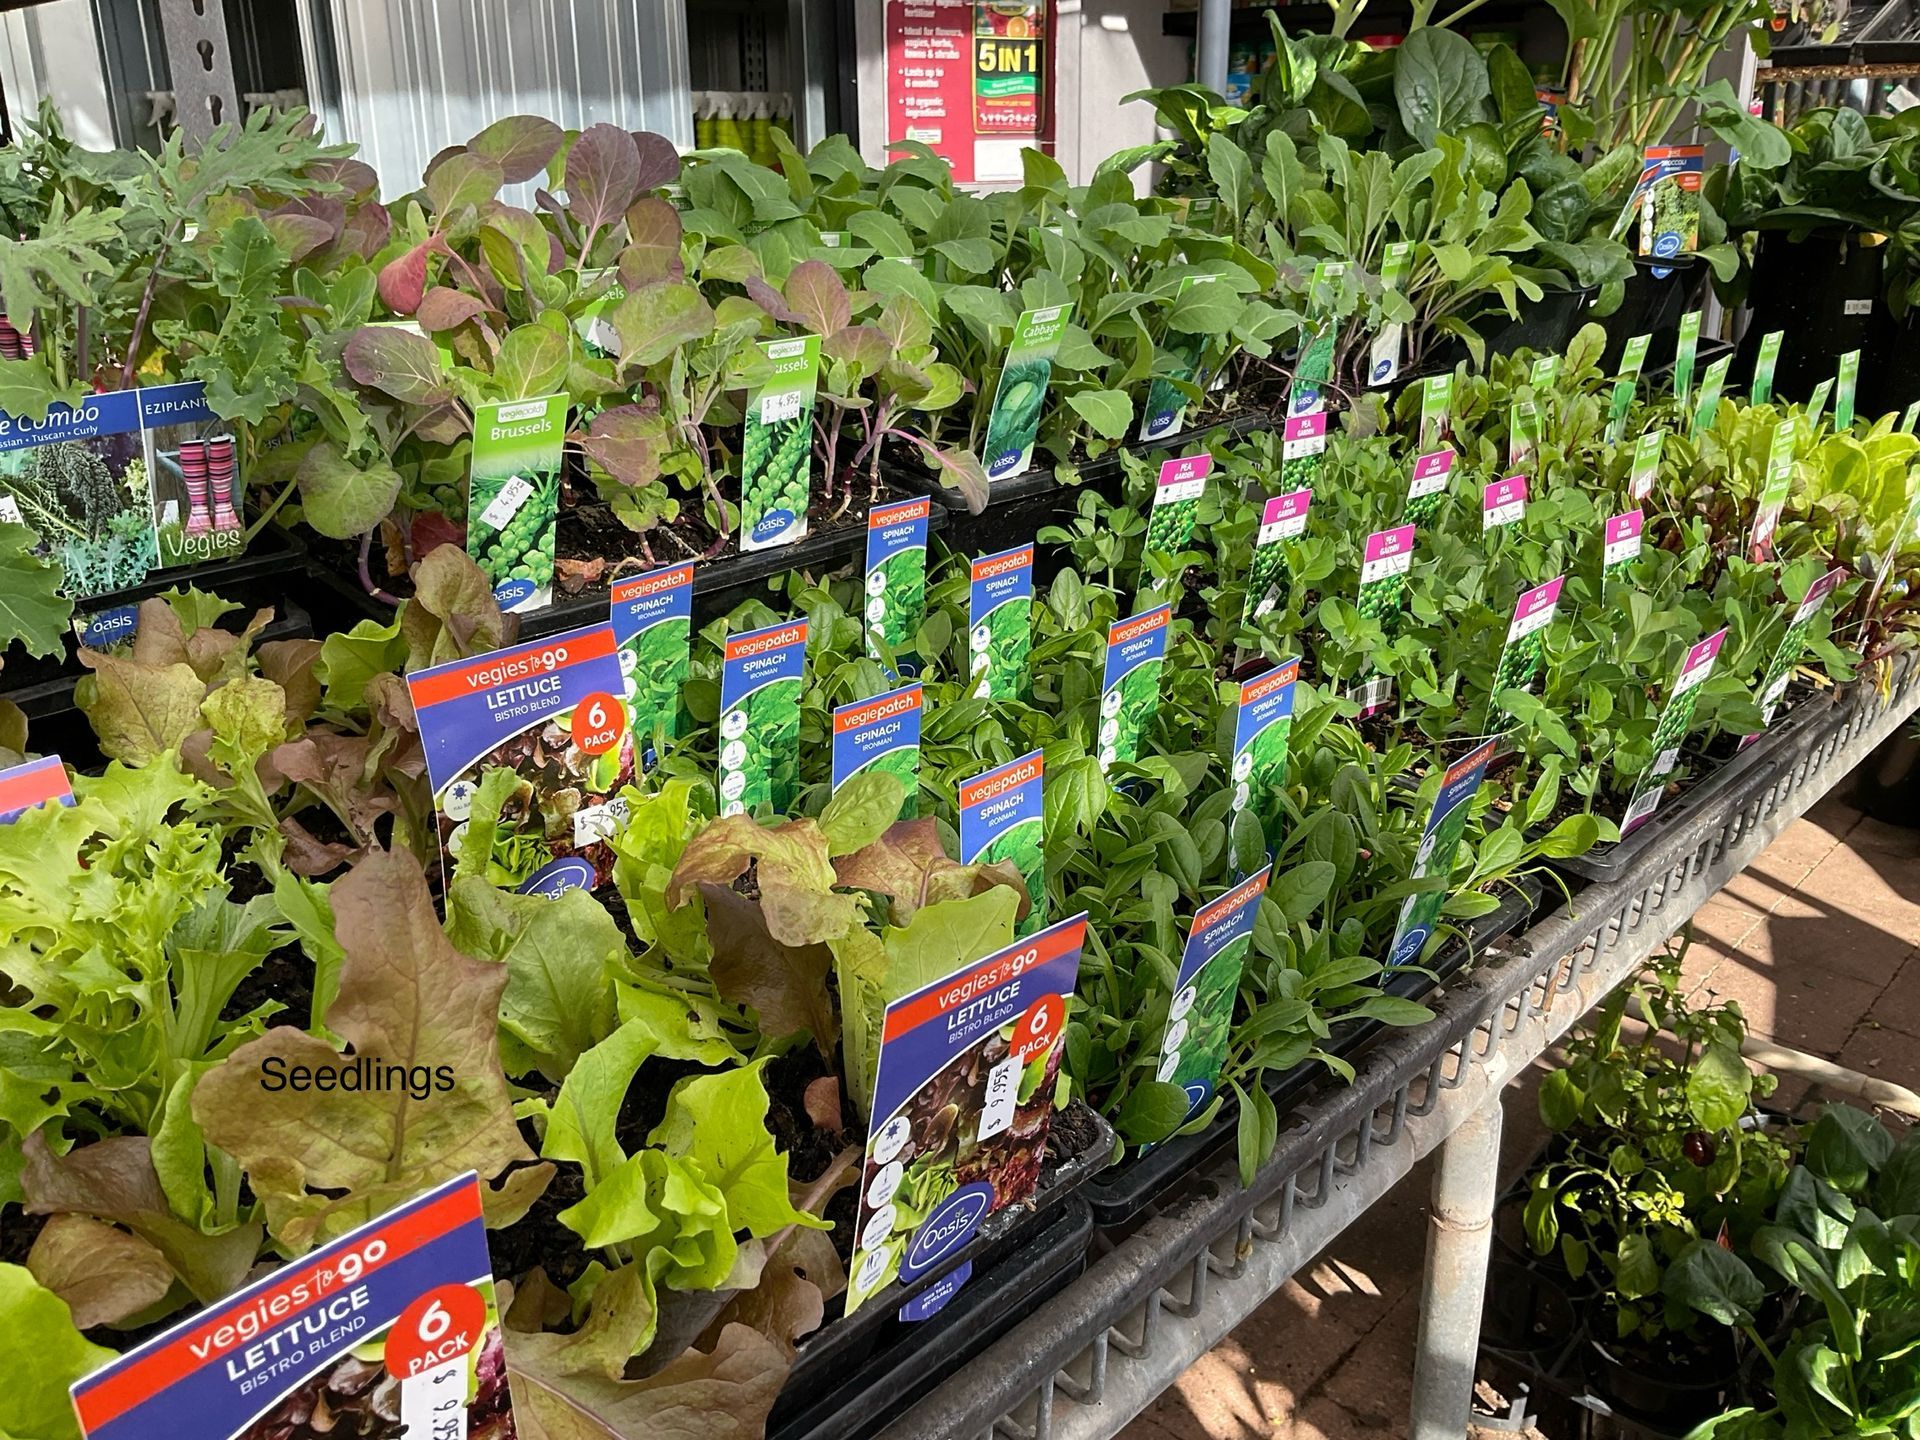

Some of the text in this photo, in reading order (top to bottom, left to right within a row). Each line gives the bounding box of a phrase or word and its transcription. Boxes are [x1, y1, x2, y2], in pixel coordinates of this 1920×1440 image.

[1023, 323, 1061, 338] Cabbage
[775, 357, 809, 374] ussels
[32, 431, 65, 443] Tuscan
[73, 425, 98, 436] Curly
[491, 418, 552, 441] Brussels
[1301, 419, 1312, 430] PEA
[1180, 462, 1192, 472] PEA
[1430, 457, 1440, 467] PEA
[1174, 471, 1195, 481] GARDEN
[1500, 484, 1510, 495] PEA
[1276, 506, 1297, 519] GARDEN
[1282, 498, 1295, 509] PEA
[757, 516, 786, 533] oasis
[875, 505, 924, 526] vegiepatch
[882, 525, 915, 540] SPINACH
[1384, 534, 1397, 545] PEA
[165, 529, 242, 560] Vegies
[978, 554, 1027, 577] vegiepatch
[621, 572, 685, 599] vegiepatch
[985, 574, 1019, 592] SPINACH
[630, 594, 673, 615] SPINACH
[1534, 590, 1546, 602] PEA
[93, 614, 133, 633] oasis
[637, 607, 666, 621] IRONMAN
[1115, 614, 1165, 642] vegiepatch
[734, 630, 799, 658] vegiepatch
[1121, 637, 1154, 657] SPINACH
[466, 658, 529, 688] vegies
[543, 647, 568, 671] go
[742, 653, 786, 673] SPINACH
[750, 667, 778, 680] IRONMAN
[486, 675, 562, 710] LETTUCE
[1247, 669, 1294, 700] vegiepatch
[494, 695, 561, 723] BISTRO BLEND
[588, 701, 607, 729] 6
[844, 695, 914, 727] vegiepatch
[1251, 693, 1284, 716] SPINACH
[584, 728, 617, 749] PACK
[854, 721, 901, 745] SPINACH
[862, 736, 893, 752] IRONMAN
[969, 764, 1036, 802] vegiepatch
[980, 792, 1025, 821] SPINACH
[988, 809, 1017, 828] IRONMAN
[1201, 881, 1261, 928] vegiepatch
[1203, 910, 1245, 945] SPINACH
[938, 968, 998, 1010] vegies
[1012, 947, 1038, 977] go
[946, 980, 1022, 1032] LETTUCE
[947, 1003, 1014, 1044] BISTRO BLEND
[1029, 1004, 1048, 1034] 6
[1018, 1031, 1053, 1057] PACK
[987, 1118, 1001, 1130] $
[923, 1213, 969, 1250] Oasis
[189, 1283, 309, 1360] vegies
[336, 1239, 387, 1284] go
[418, 1299, 451, 1343] 6
[225, 1285, 371, 1382] LETTUCE
[239, 1315, 367, 1396] BISTRO BLEND
[409, 1331, 470, 1376] PACK
[432, 1369, 457, 1384] $
